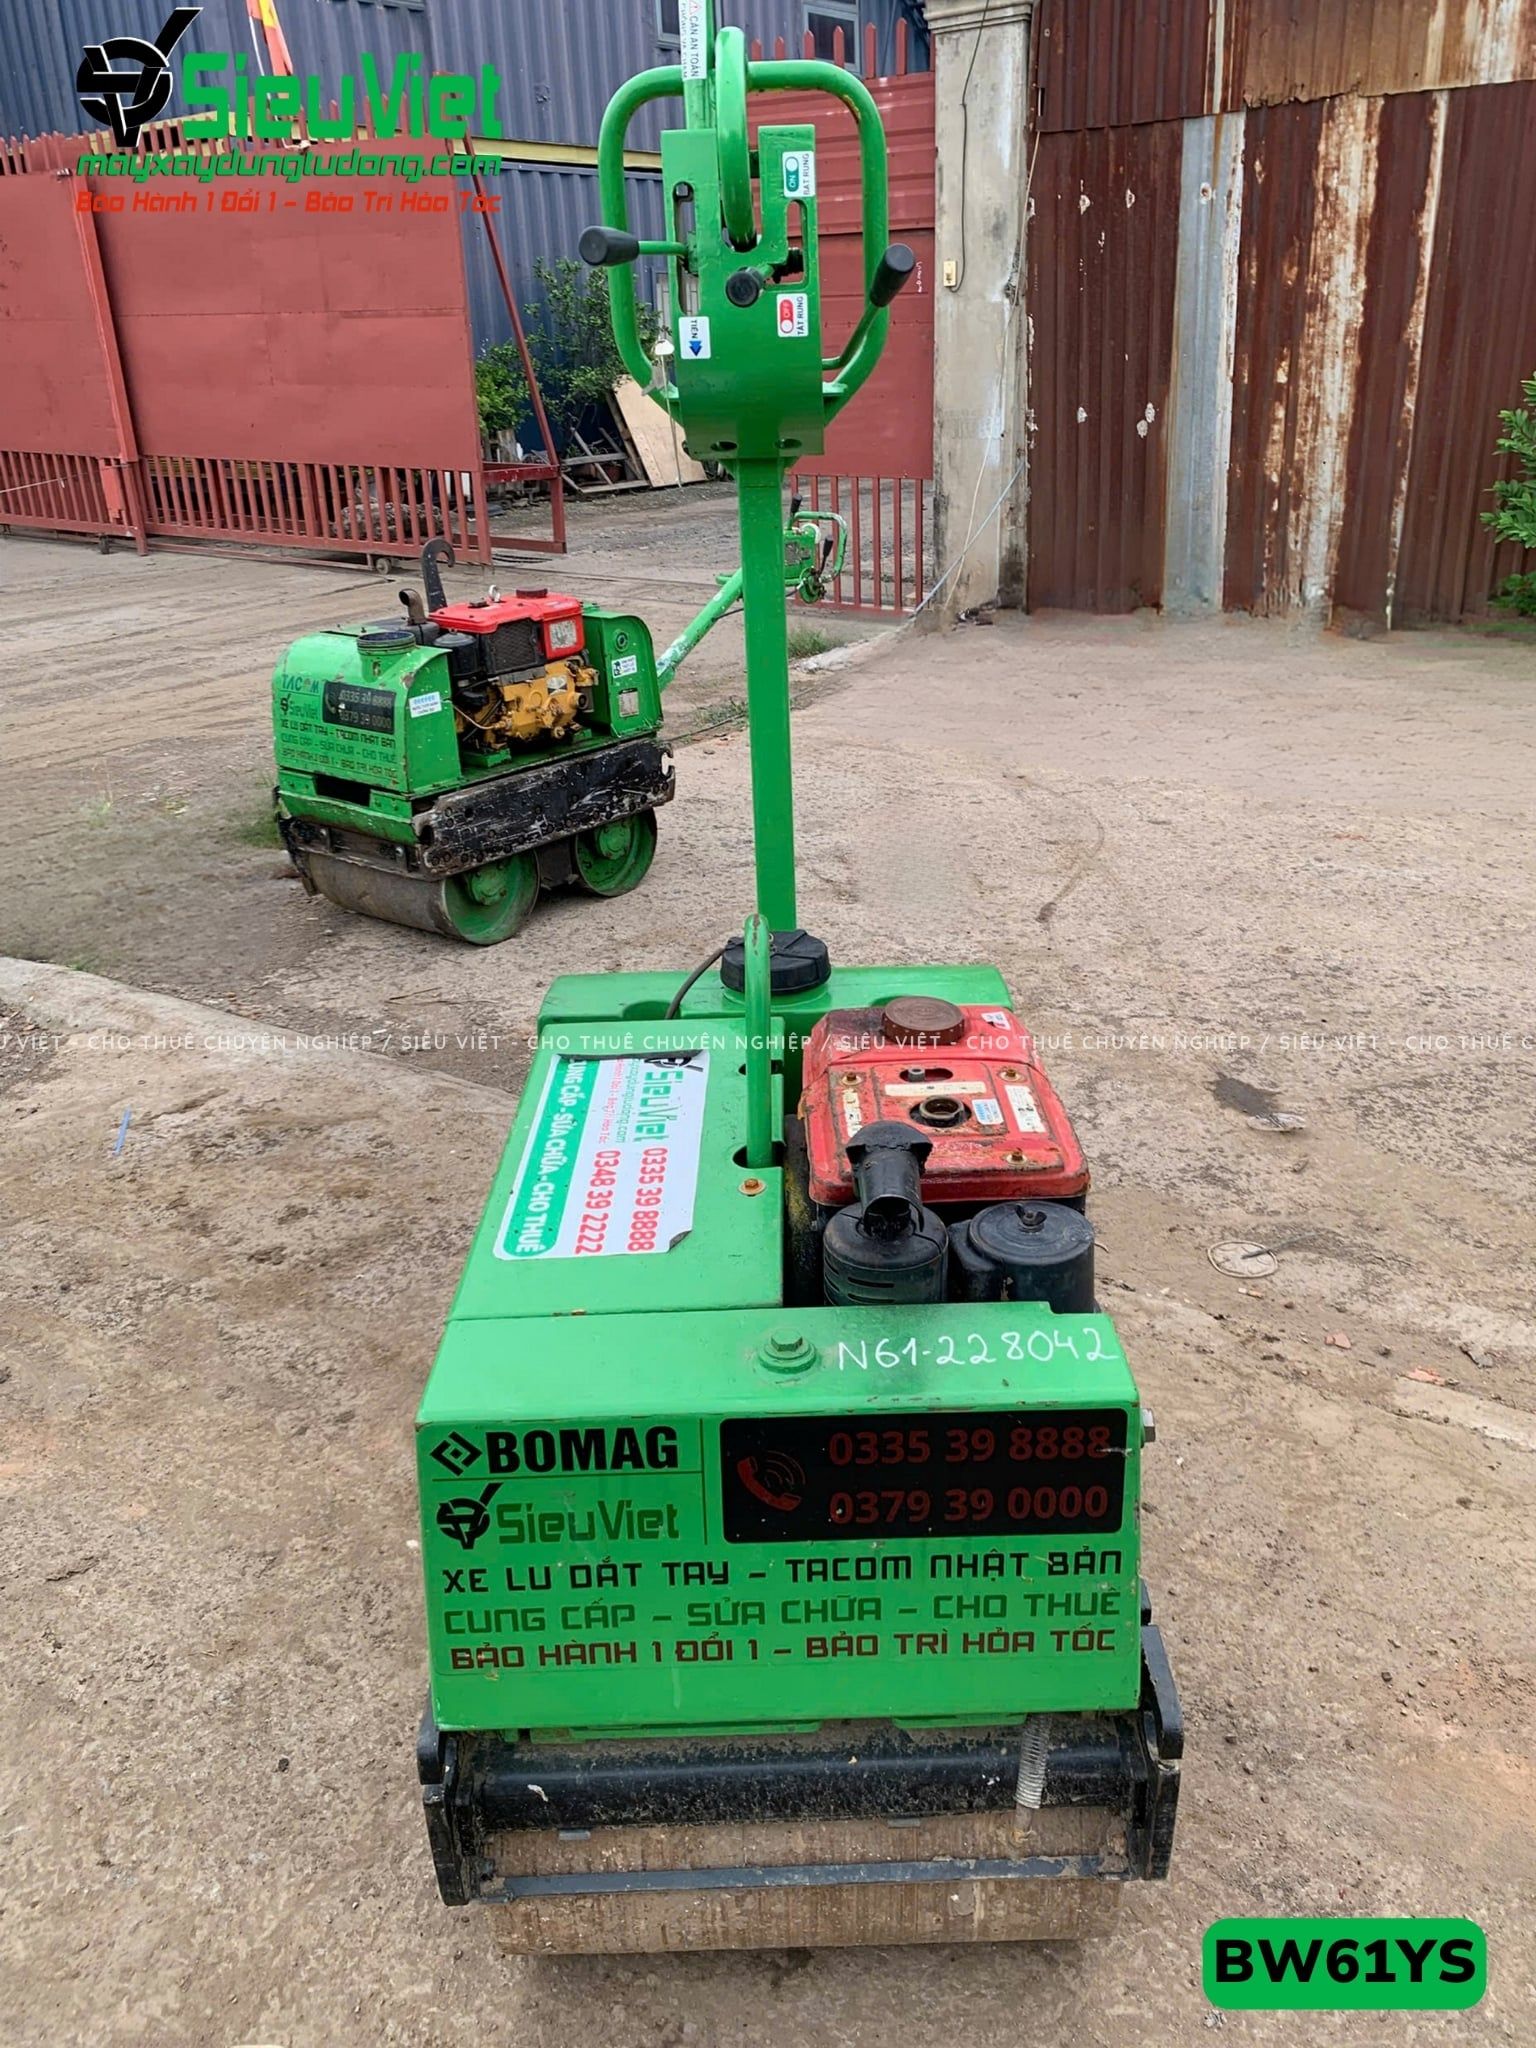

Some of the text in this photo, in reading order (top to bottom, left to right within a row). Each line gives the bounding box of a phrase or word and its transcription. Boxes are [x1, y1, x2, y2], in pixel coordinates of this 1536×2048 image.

[690, 37, 699, 50] AN
[788, 174, 797, 188] ON
[802, 153, 810, 177] RUNG
[560, 1085, 584, 1107] CẤP
[633, 1070, 684, 1143] SieuViet
[550, 1112, 578, 1140] SỬA
[539, 1138, 568, 1175] CHỮA
[527, 1182, 556, 1213] CHO
[574, 1150, 621, 1255] 0348 39 2222
[627, 1147, 668, 1252] 0335 39 8888
[517, 1213, 547, 1254] THUÊ
[486, 1426, 679, 1474] BOMAG
[828, 1426, 1111, 1466] 0335 39 8888
[496, 1500, 680, 1544] SieuViet
[829, 1486, 1108, 1525] 0379 39 0000
[442, 1568, 489, 1593] XE
[506, 1566, 552, 1591] LU
[661, 1561, 729, 1587] TAY
[785, 1555, 912, 1583] TACOM
[930, 1548, 1029, 1582] NHẬT
[1048, 1545, 1121, 1576] BẢN
[443, 1607, 546, 1634] CUNG
[561, 1598, 636, 1630] CẤP
[687, 1597, 766, 1626] SỬA
[780, 1594, 882, 1624] CHỮA
[933, 1594, 1007, 1619] CHO
[1023, 1587, 1121, 1616] THUÊ
[450, 1642, 524, 1670] BẢO
[538, 1639, 637, 1666] HÀNH
[651, 1641, 662, 1663] 1
[674, 1632, 733, 1662] ĐỔI
[747, 1639, 759, 1660] 1
[806, 1630, 879, 1658] BẢO
[894, 1628, 948, 1655] TRÌ
[962, 1627, 1035, 1653] HỎA
[1050, 1622, 1116, 1652] TỐC
